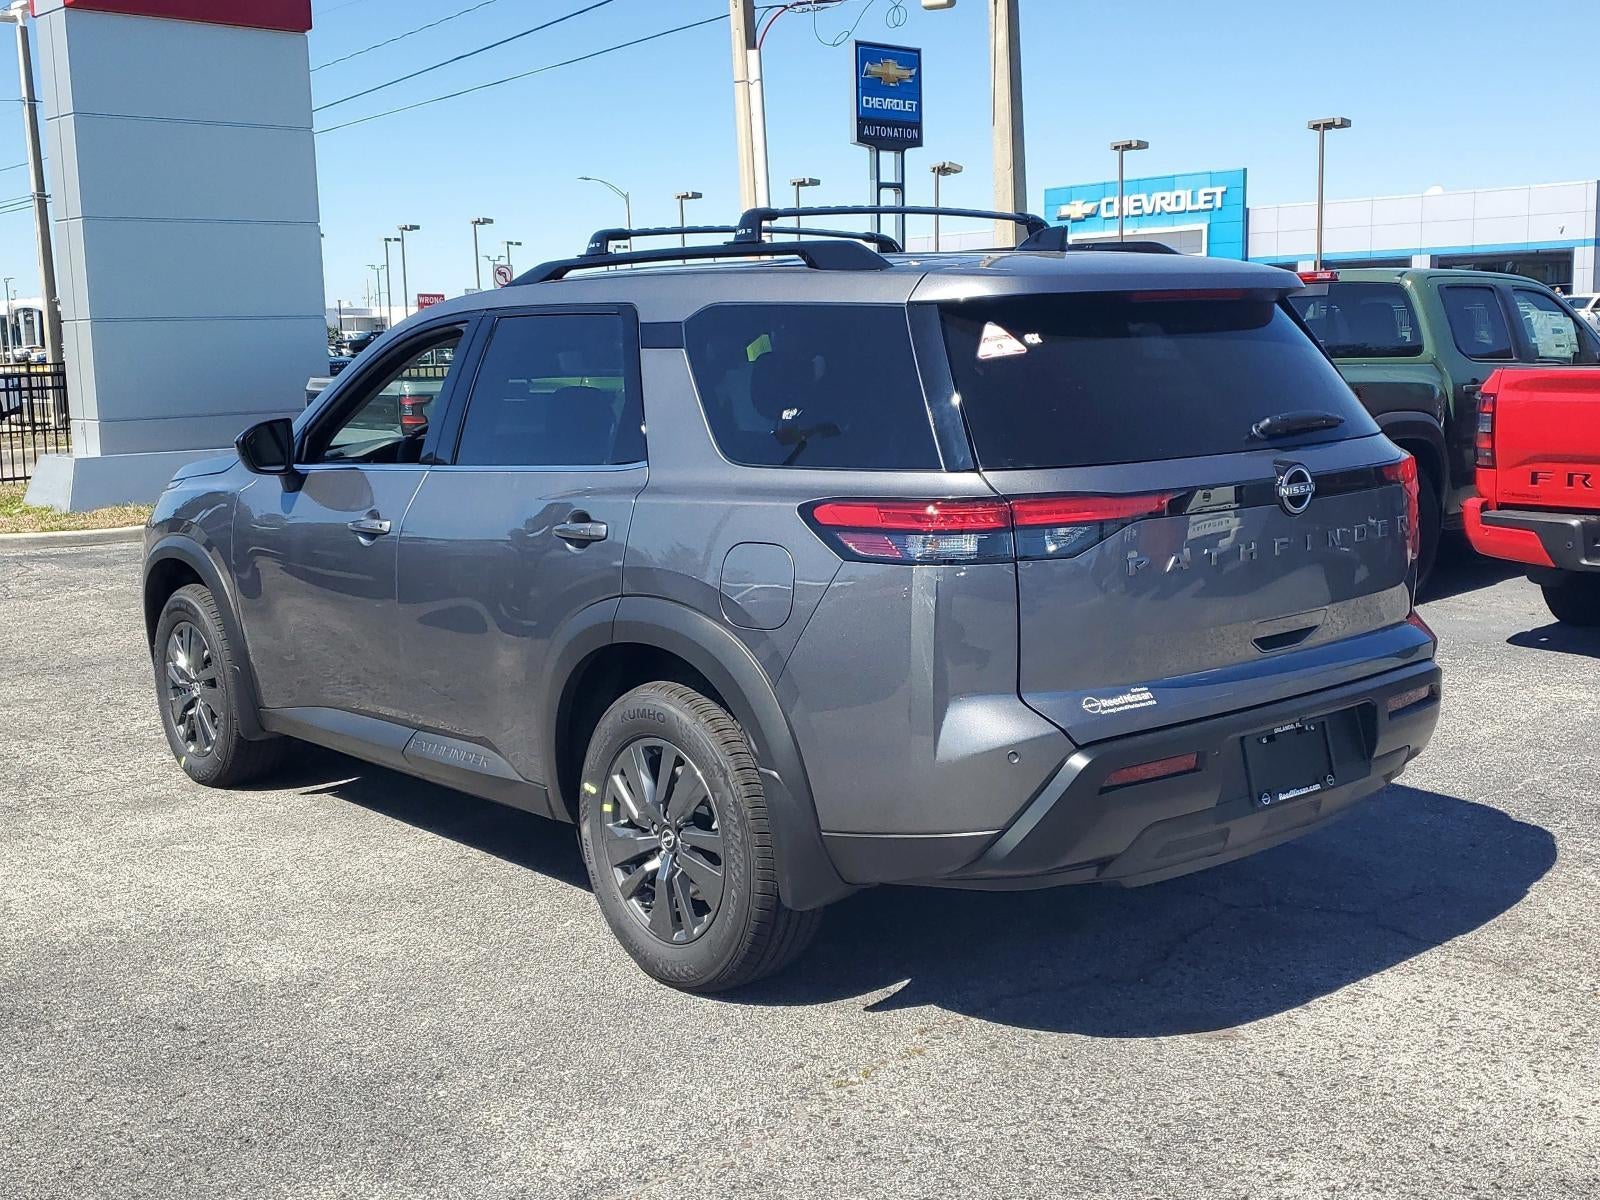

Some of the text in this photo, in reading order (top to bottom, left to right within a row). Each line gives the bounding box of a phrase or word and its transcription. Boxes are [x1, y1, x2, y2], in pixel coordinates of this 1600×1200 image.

[862, 96, 918, 113] CHEVROLET
[863, 124, 919, 139] AUTONATION
[1100, 186, 1227, 220] CHEVROLET
[1281, 484, 1315, 496] NISSAN
[1126, 515, 1411, 576] PATHFINDER
[620, 707, 666, 724] KUMHO
[411, 738, 489, 768] PATHFINDER
